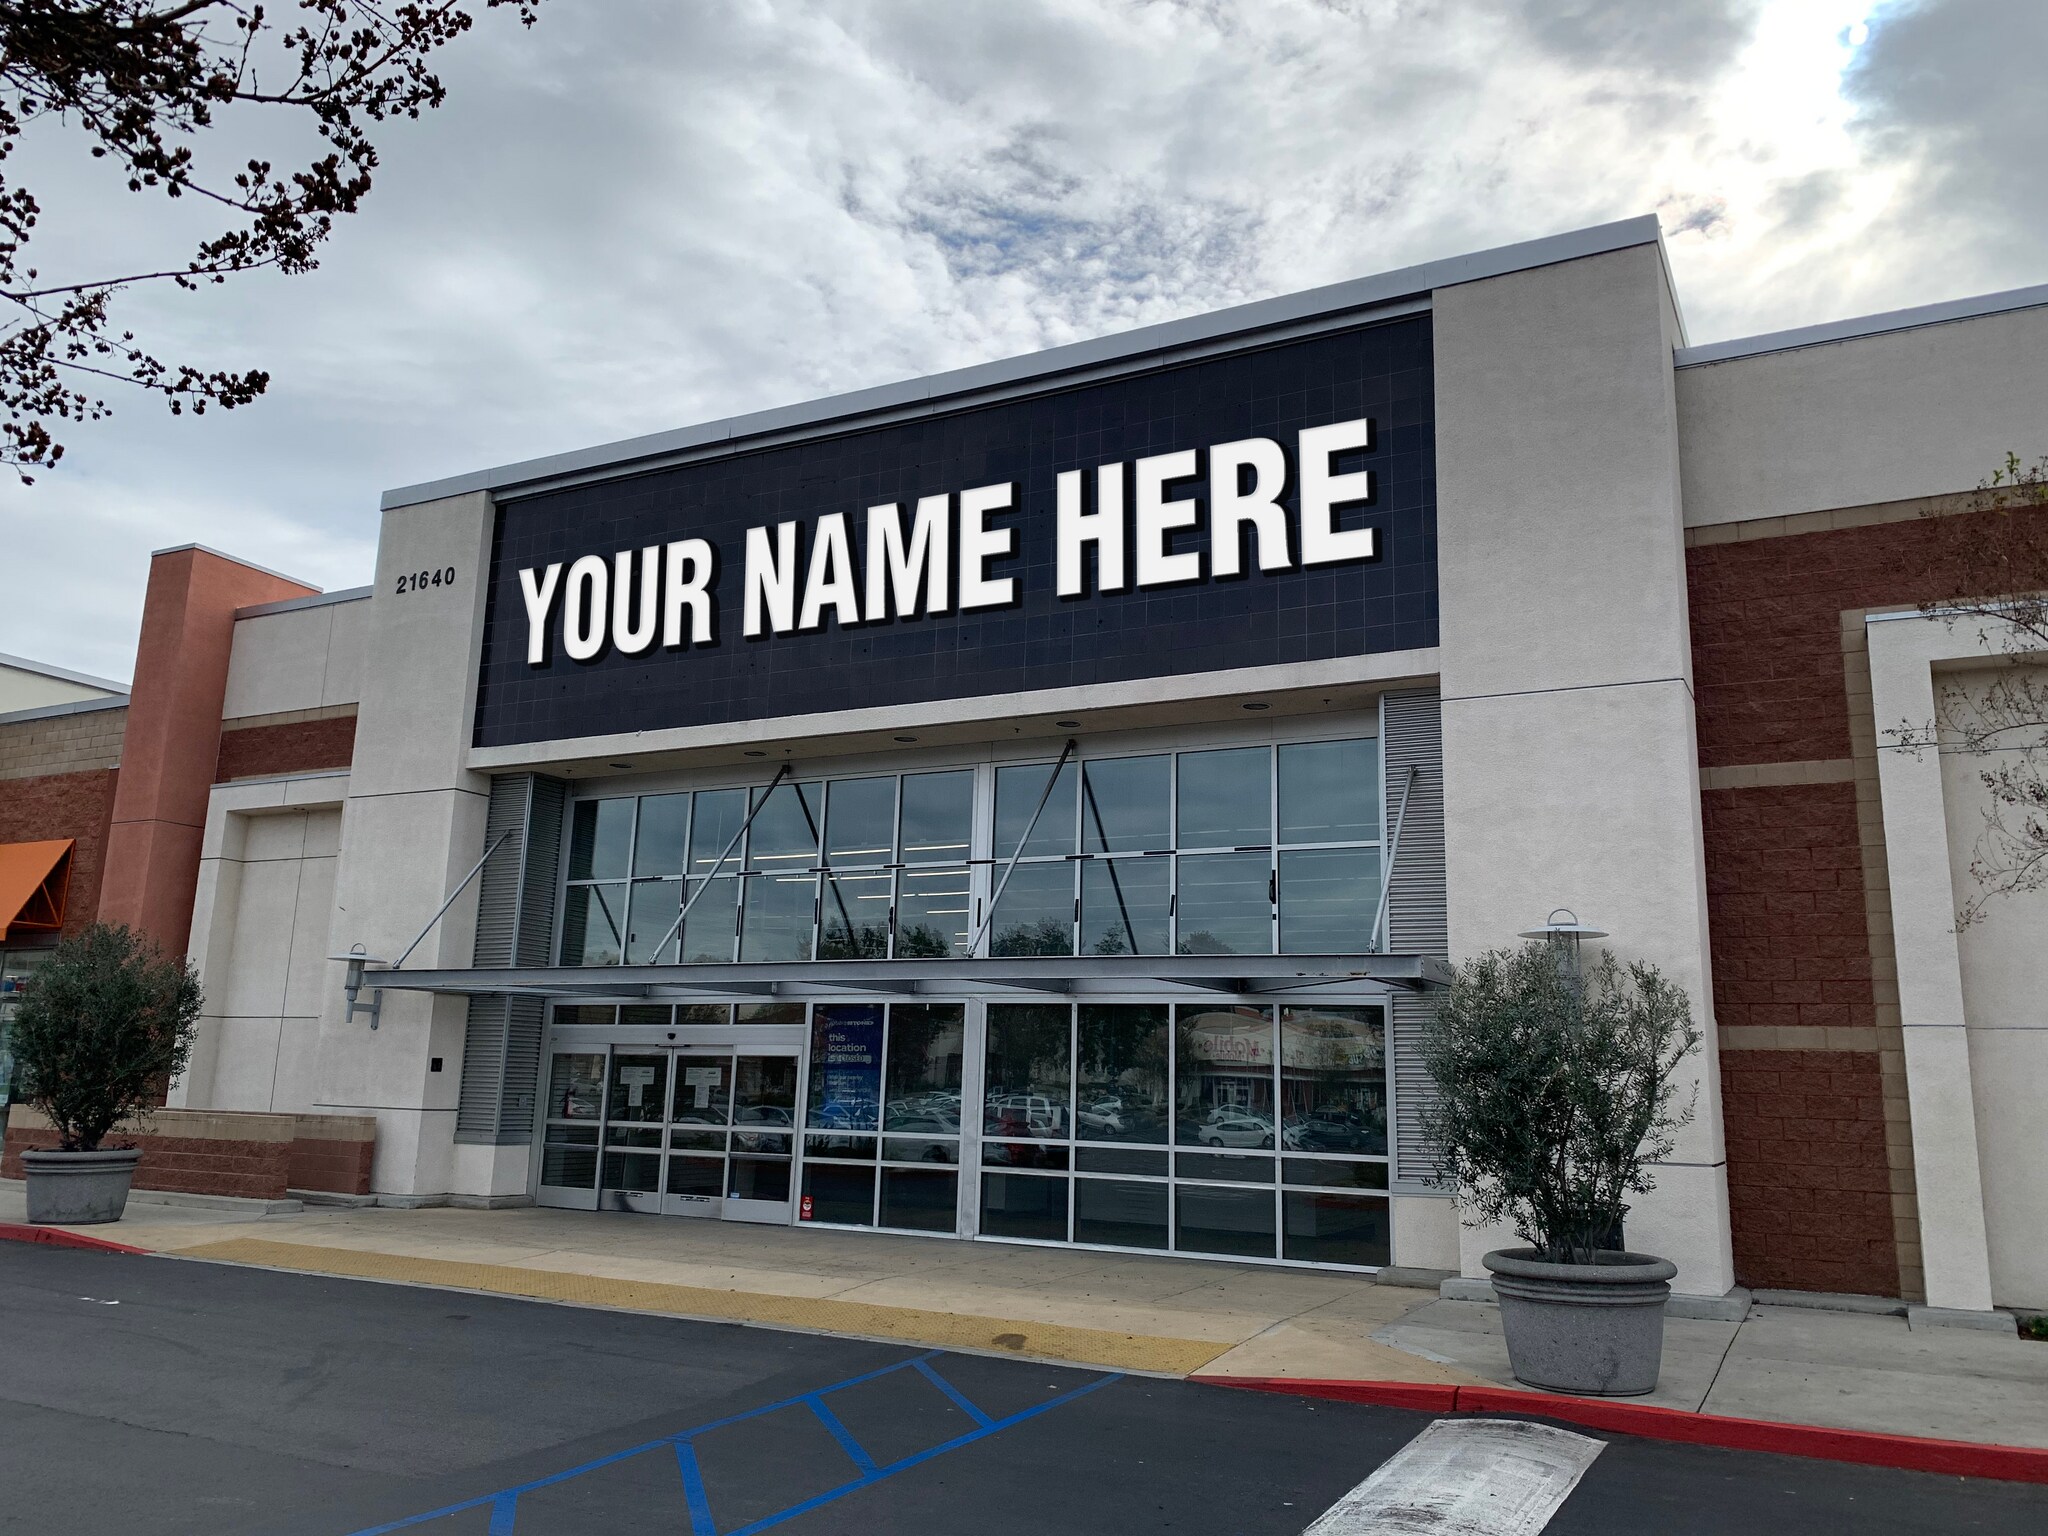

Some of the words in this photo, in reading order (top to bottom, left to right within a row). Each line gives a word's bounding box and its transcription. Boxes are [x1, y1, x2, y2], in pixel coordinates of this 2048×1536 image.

[519, 536, 713, 667] YOUR
[743, 481, 1015, 638] NAME
[1056, 418, 1376, 597] HERE
[395, 566, 456, 595] 21640
[828, 1043, 866, 1051] location
[829, 1033, 846, 1042] this
